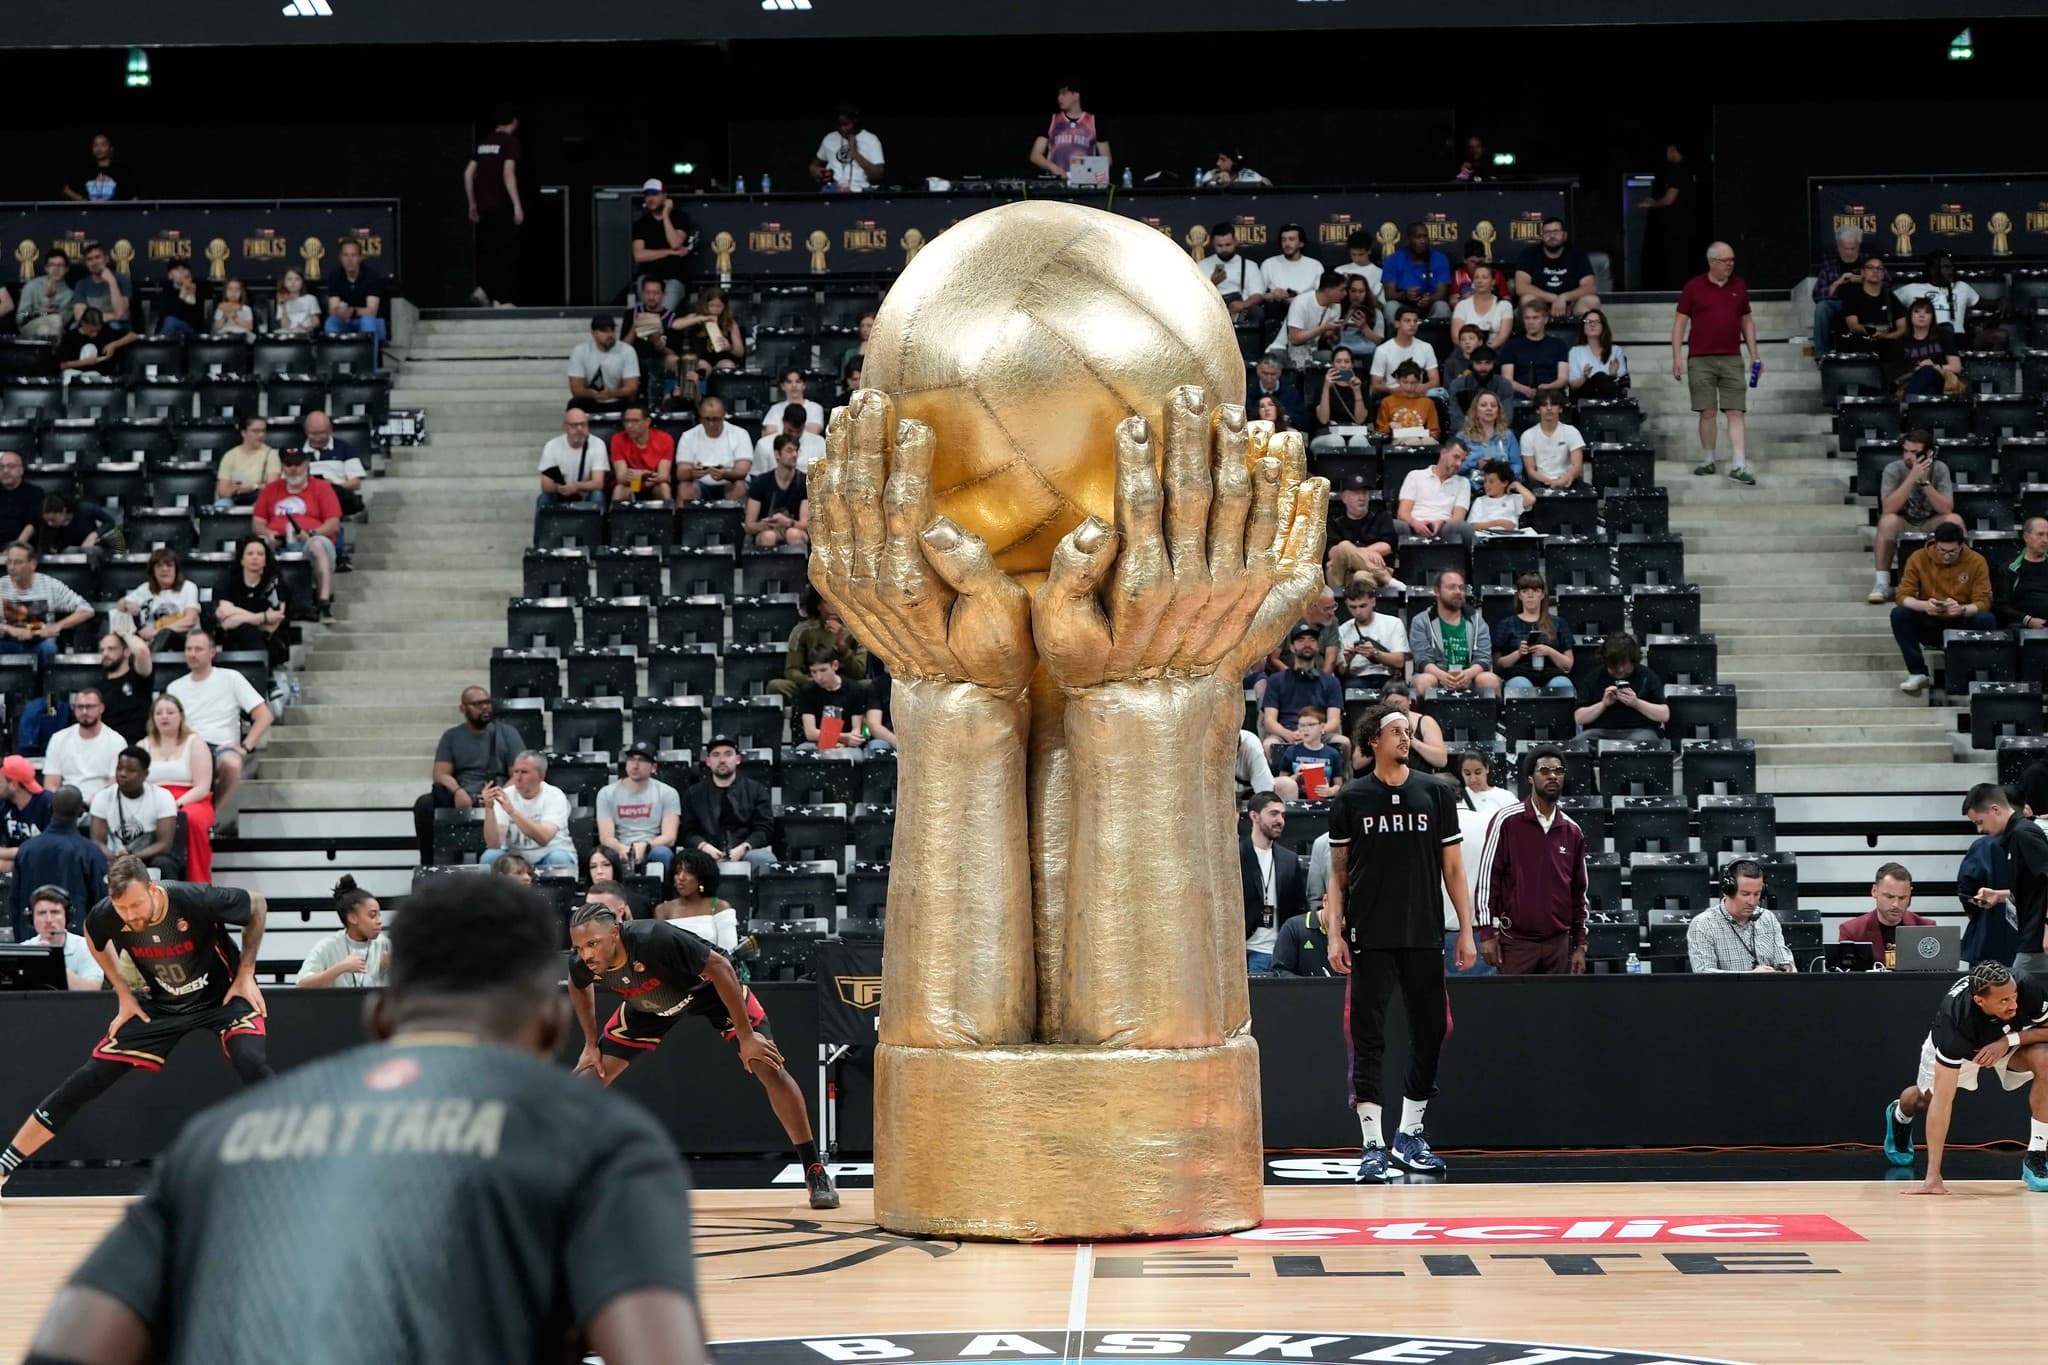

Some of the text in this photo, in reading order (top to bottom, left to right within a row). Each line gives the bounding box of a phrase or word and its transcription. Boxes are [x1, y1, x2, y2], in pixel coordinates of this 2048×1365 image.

[1319, 223, 1362, 244] FINAL
[1510, 221, 1544, 240] FINAL
[1363, 814, 1428, 834] PARIS
[131, 940, 194, 960] MONACO
[154, 963, 187, 984] 20
[219, 1101, 506, 1163] OUATTARA
[1230, 1220, 1785, 1241] etclic
[1092, 1250, 1842, 1278] ÉLITE
[801, 1332, 1697, 1365] BASKET
